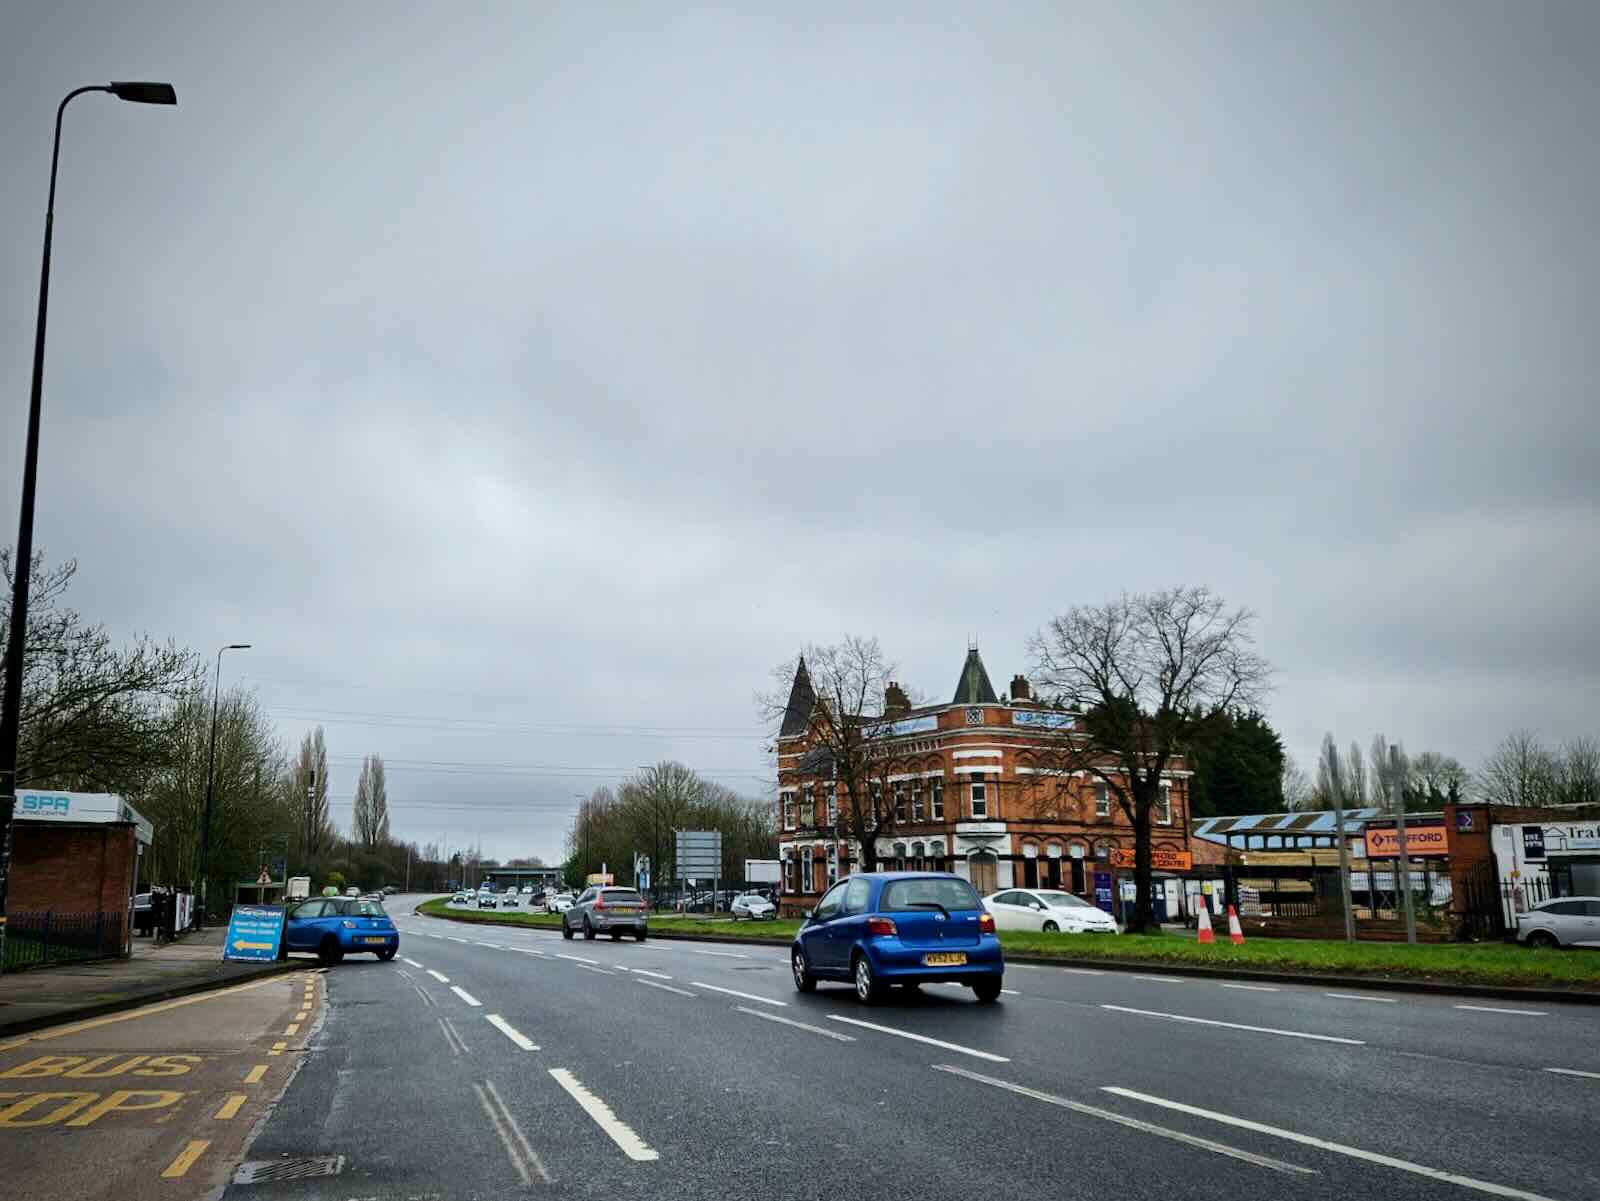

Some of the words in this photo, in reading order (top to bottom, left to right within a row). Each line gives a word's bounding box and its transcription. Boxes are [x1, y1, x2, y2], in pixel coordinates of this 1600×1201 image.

[23, 795, 69, 810] SPA
[1384, 833, 1442, 845] TRFFORD
[0, 1055, 201, 1078] BUS
[0, 1090, 186, 1128] OP
